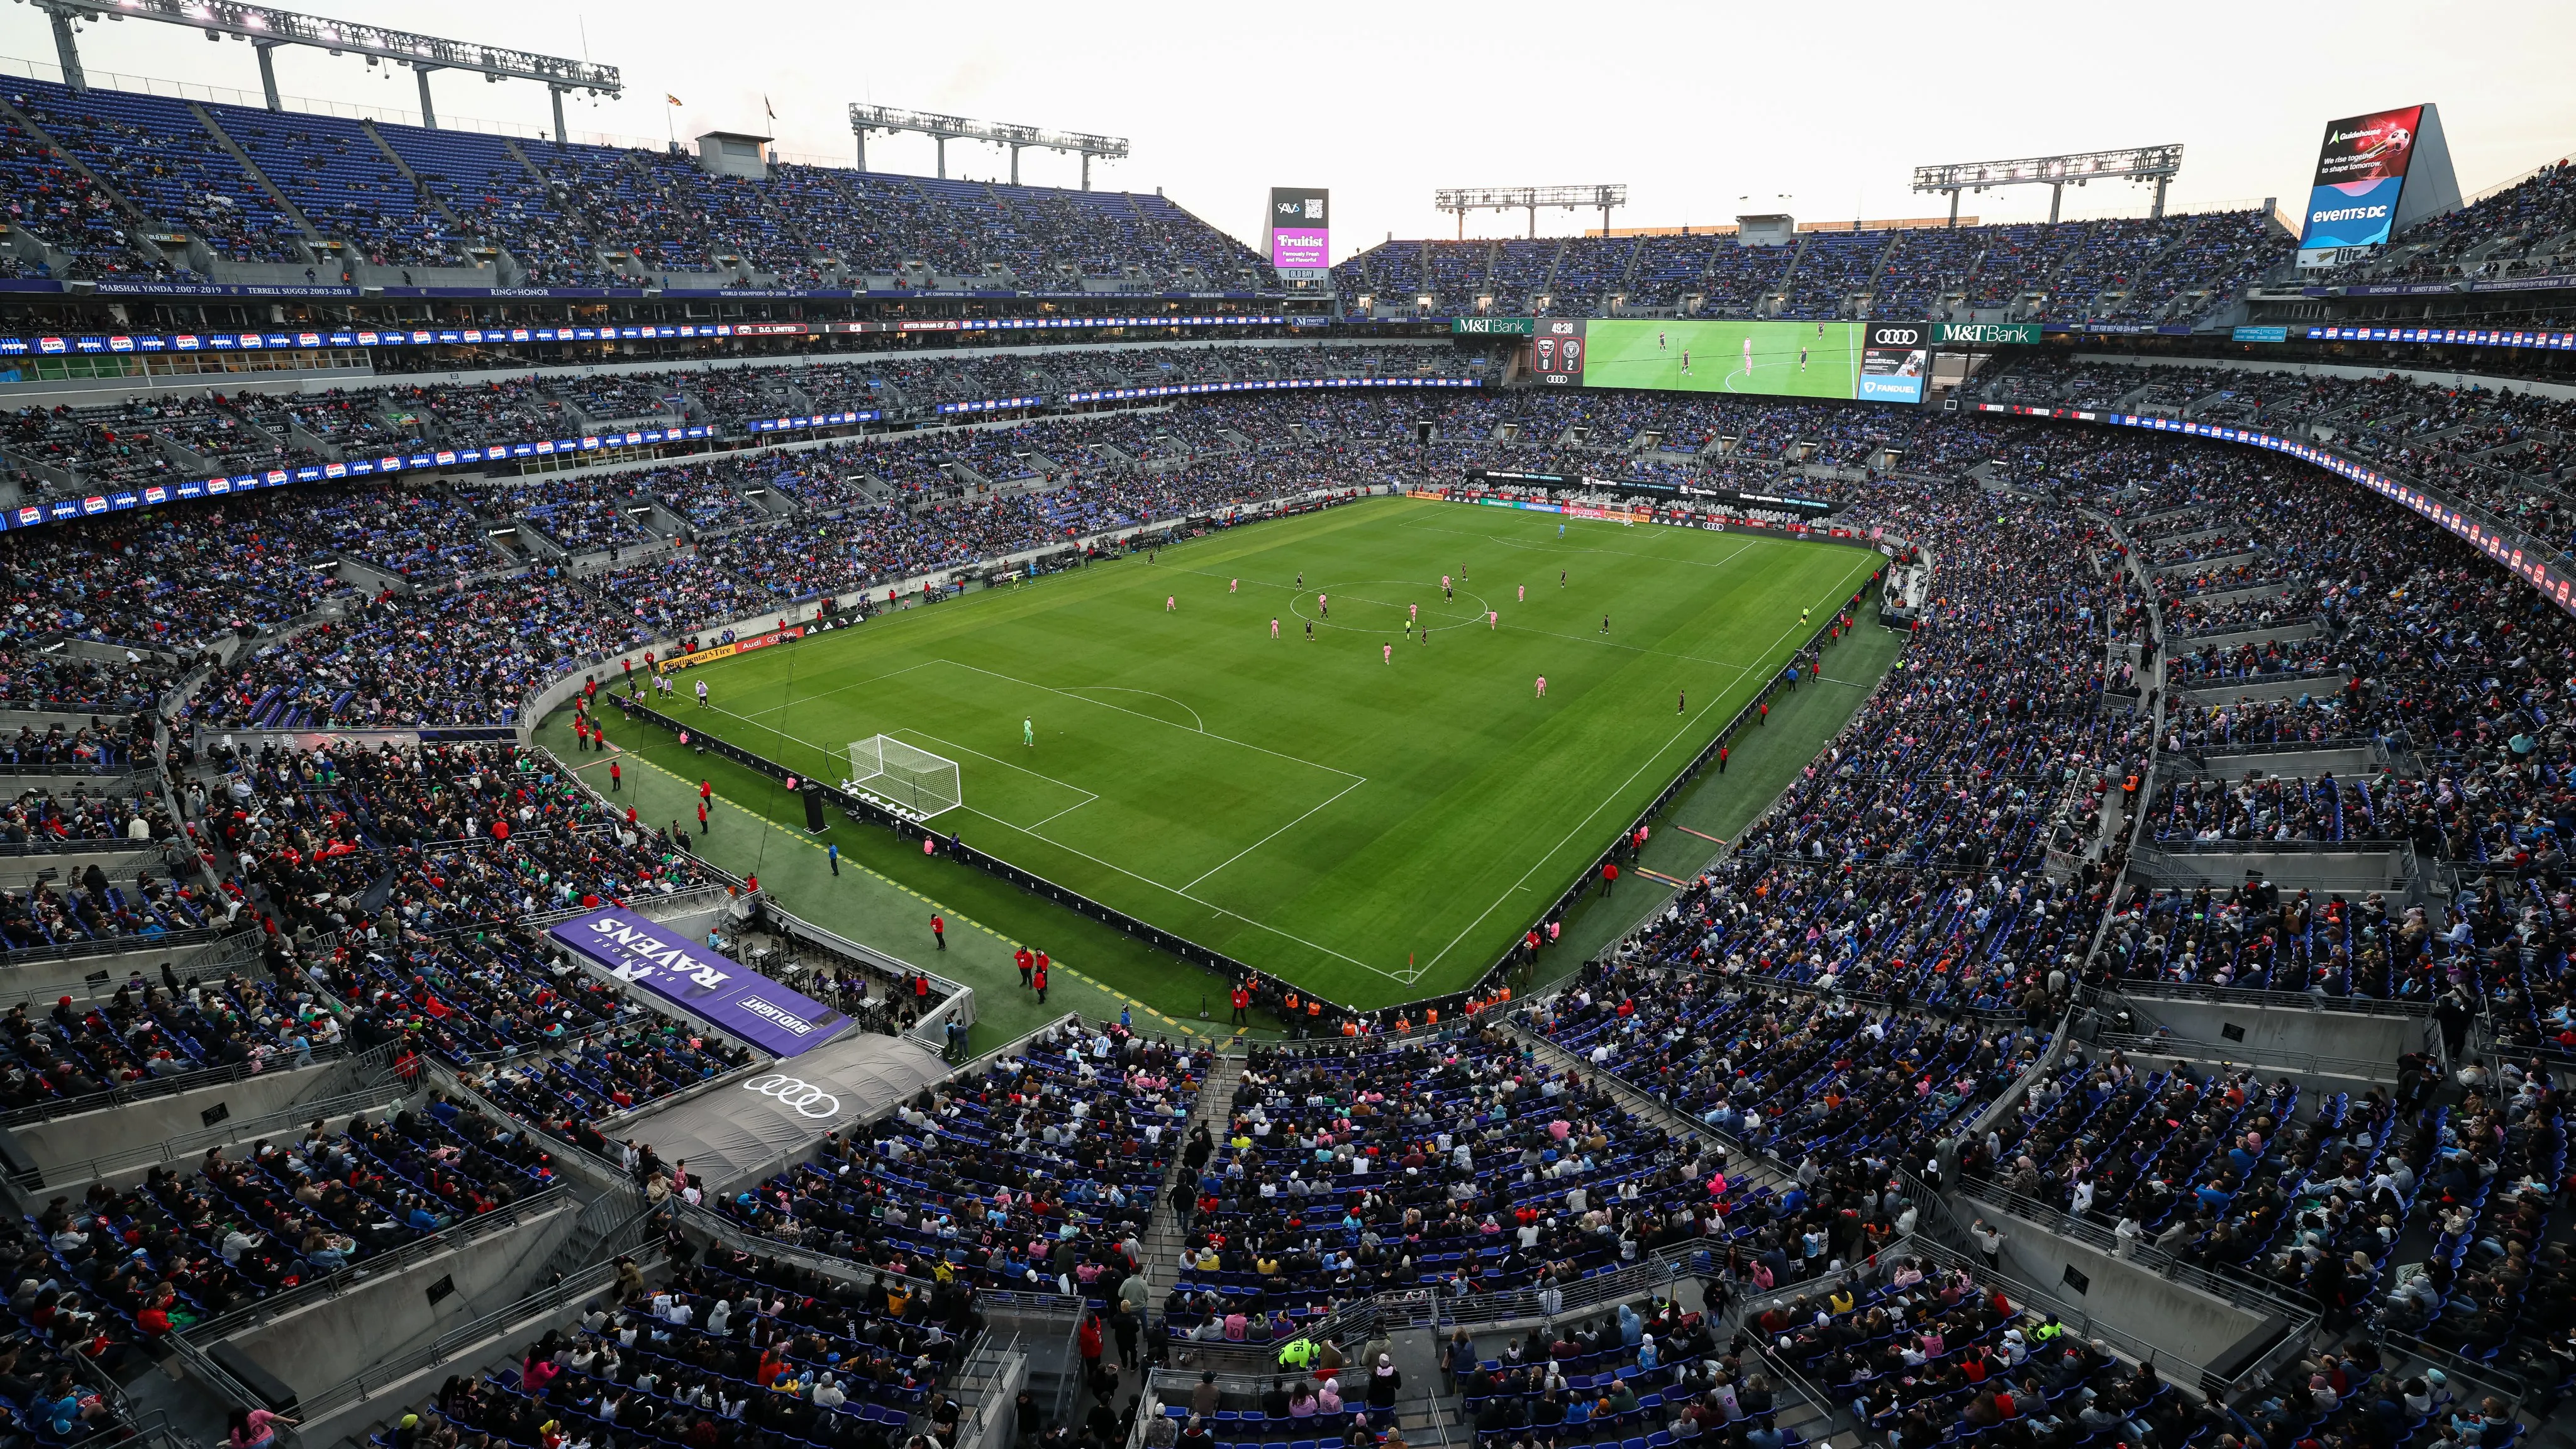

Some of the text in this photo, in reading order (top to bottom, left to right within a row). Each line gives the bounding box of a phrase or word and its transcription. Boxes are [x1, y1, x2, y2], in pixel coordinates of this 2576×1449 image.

[2340, 128, 2381, 140] Guidehouse
[2348, 152, 2376, 162] together
[2329, 164, 2348, 174] shape
[2350, 160, 2382, 170] tomorrow.
[1277, 235, 1324, 247] Fruitist
[882, 323, 887, 331] 2
[1460, 319, 1524, 333] M&T Bank
[1552, 323, 1573, 334] 49:38
[1943, 324, 2029, 342] M&T Bank
[1543, 359, 1548, 369] 0
[1567, 360, 1573, 370] 2
[1877, 385, 1916, 394] FANDUEL
[1801, 500, 1829, 508] outcomes.
[52, 507, 75, 515] PEPSI
[742, 639, 762, 650] Audi
[714, 647, 731, 656] Tire
[588, 918, 733, 990] RAVENS
[981, 1234, 992, 1245] 10
[1472, 1264, 1479, 1272] 10
[655, 1304, 667, 1315] 10
[1230, 1328, 1240, 1338] 10
[1932, 1342, 1941, 1350] 10
[701, 1397, 713, 1409] 89
